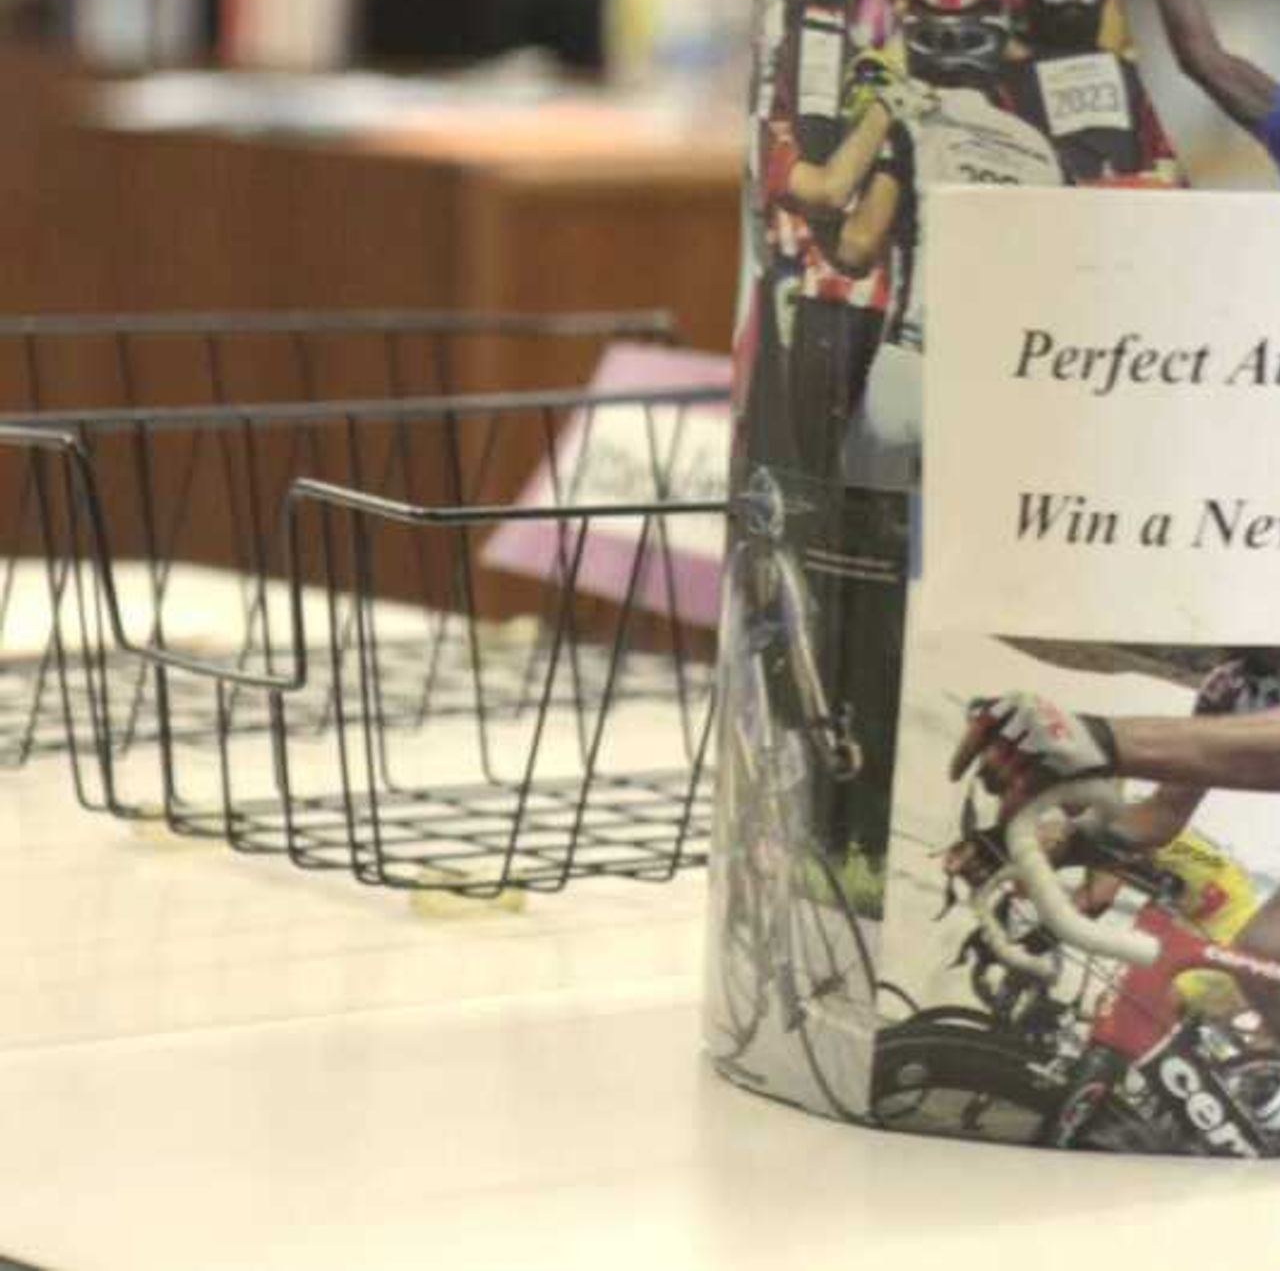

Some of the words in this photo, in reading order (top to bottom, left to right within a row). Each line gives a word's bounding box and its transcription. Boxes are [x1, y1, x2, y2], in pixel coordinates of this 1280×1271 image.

[1014, 329, 1210, 396] Perfect
[1015, 492, 1120, 544] Win
[1140, 507, 1172, 547] a
